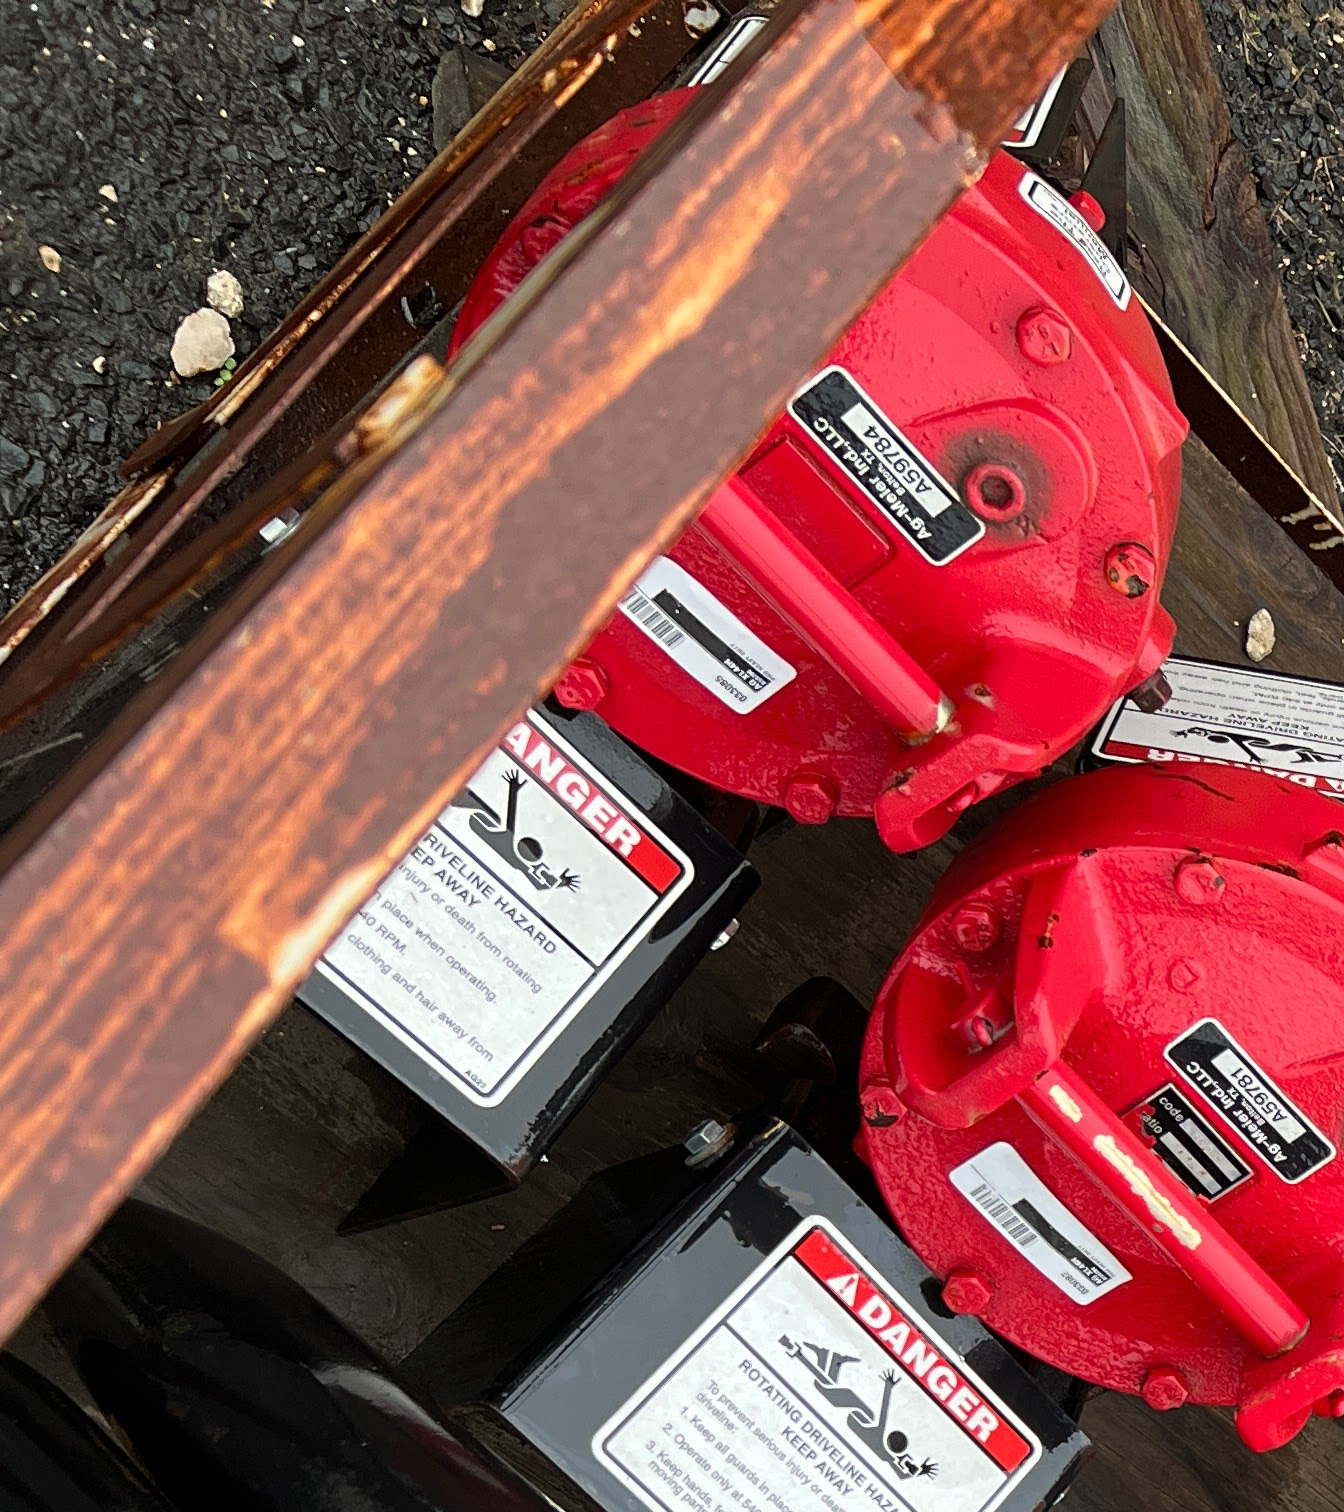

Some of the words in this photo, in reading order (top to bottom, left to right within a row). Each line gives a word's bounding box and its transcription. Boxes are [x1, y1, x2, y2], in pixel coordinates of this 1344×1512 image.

[860, 447, 876, 464] TX
[860, 423, 932, 497] A59784
[873, 462, 907, 496] Belton,
[865, 471, 934, 542] Ag-Meier
[1222, 717, 1298, 734] DRIVELINE
[1227, 712, 1268, 723] AWAY
[1270, 720, 1309, 730] KEEP
[502, 719, 644, 858] ANGER
[410, 845, 435, 870] EP
[433, 865, 481, 911] AWAY
[422, 830, 496, 901] RIVELINE
[494, 895, 558, 956] HAZARD
[375, 923, 409, 957] RPM.
[381, 897, 415, 931] place
[413, 924, 447, 957] when
[443, 951, 501, 1006] operating.
[430, 890, 445, 906] or
[443, 900, 478, 935] death
[475, 930, 504, 958] from
[499, 953, 543, 996] rotating
[345, 930, 393, 976] clothing
[391, 970, 416, 995] and
[413, 989, 440, 1015] hair
[436, 1009, 470, 1042] away
[467, 1034, 496, 1062] from
[1156, 1094, 1187, 1122] code
[1226, 1086, 1240, 1099] TX
[1228, 1066, 1288, 1125] A59781
[1229, 1105, 1289, 1164] Ag-Meier
[855, 1292, 1003, 1443] DANGER
[687, 1414, 717, 1445] Keep
[714, 1438, 730, 1455] all
[725, 1451, 761, 1487] guards
[757, 1480, 771, 1495] in
[705, 1379, 722, 1397] To
[716, 1392, 755, 1431] prevent
[752, 1425, 788, 1462] serious
[782, 1457, 812, 1487] injury
[809, 1482, 822, 1496] or
[737, 1358, 803, 1424] ROTATING
[799, 1419, 867, 1487] DRIVELINE
[644, 1439, 659, 1454] 3.
[653, 1449, 685, 1480] Keep
[680, 1473, 716, 1509] hands,
[645, 1459, 684, 1496] moving
[661, 1421, 676, 1436] 2.
[670, 1431, 713, 1474] Operate
[708, 1468, 733, 1494] only
[730, 1488, 744, 1502] at
[780, 1425, 818, 1464] KEEP
[813, 1458, 854, 1498] AWAY
